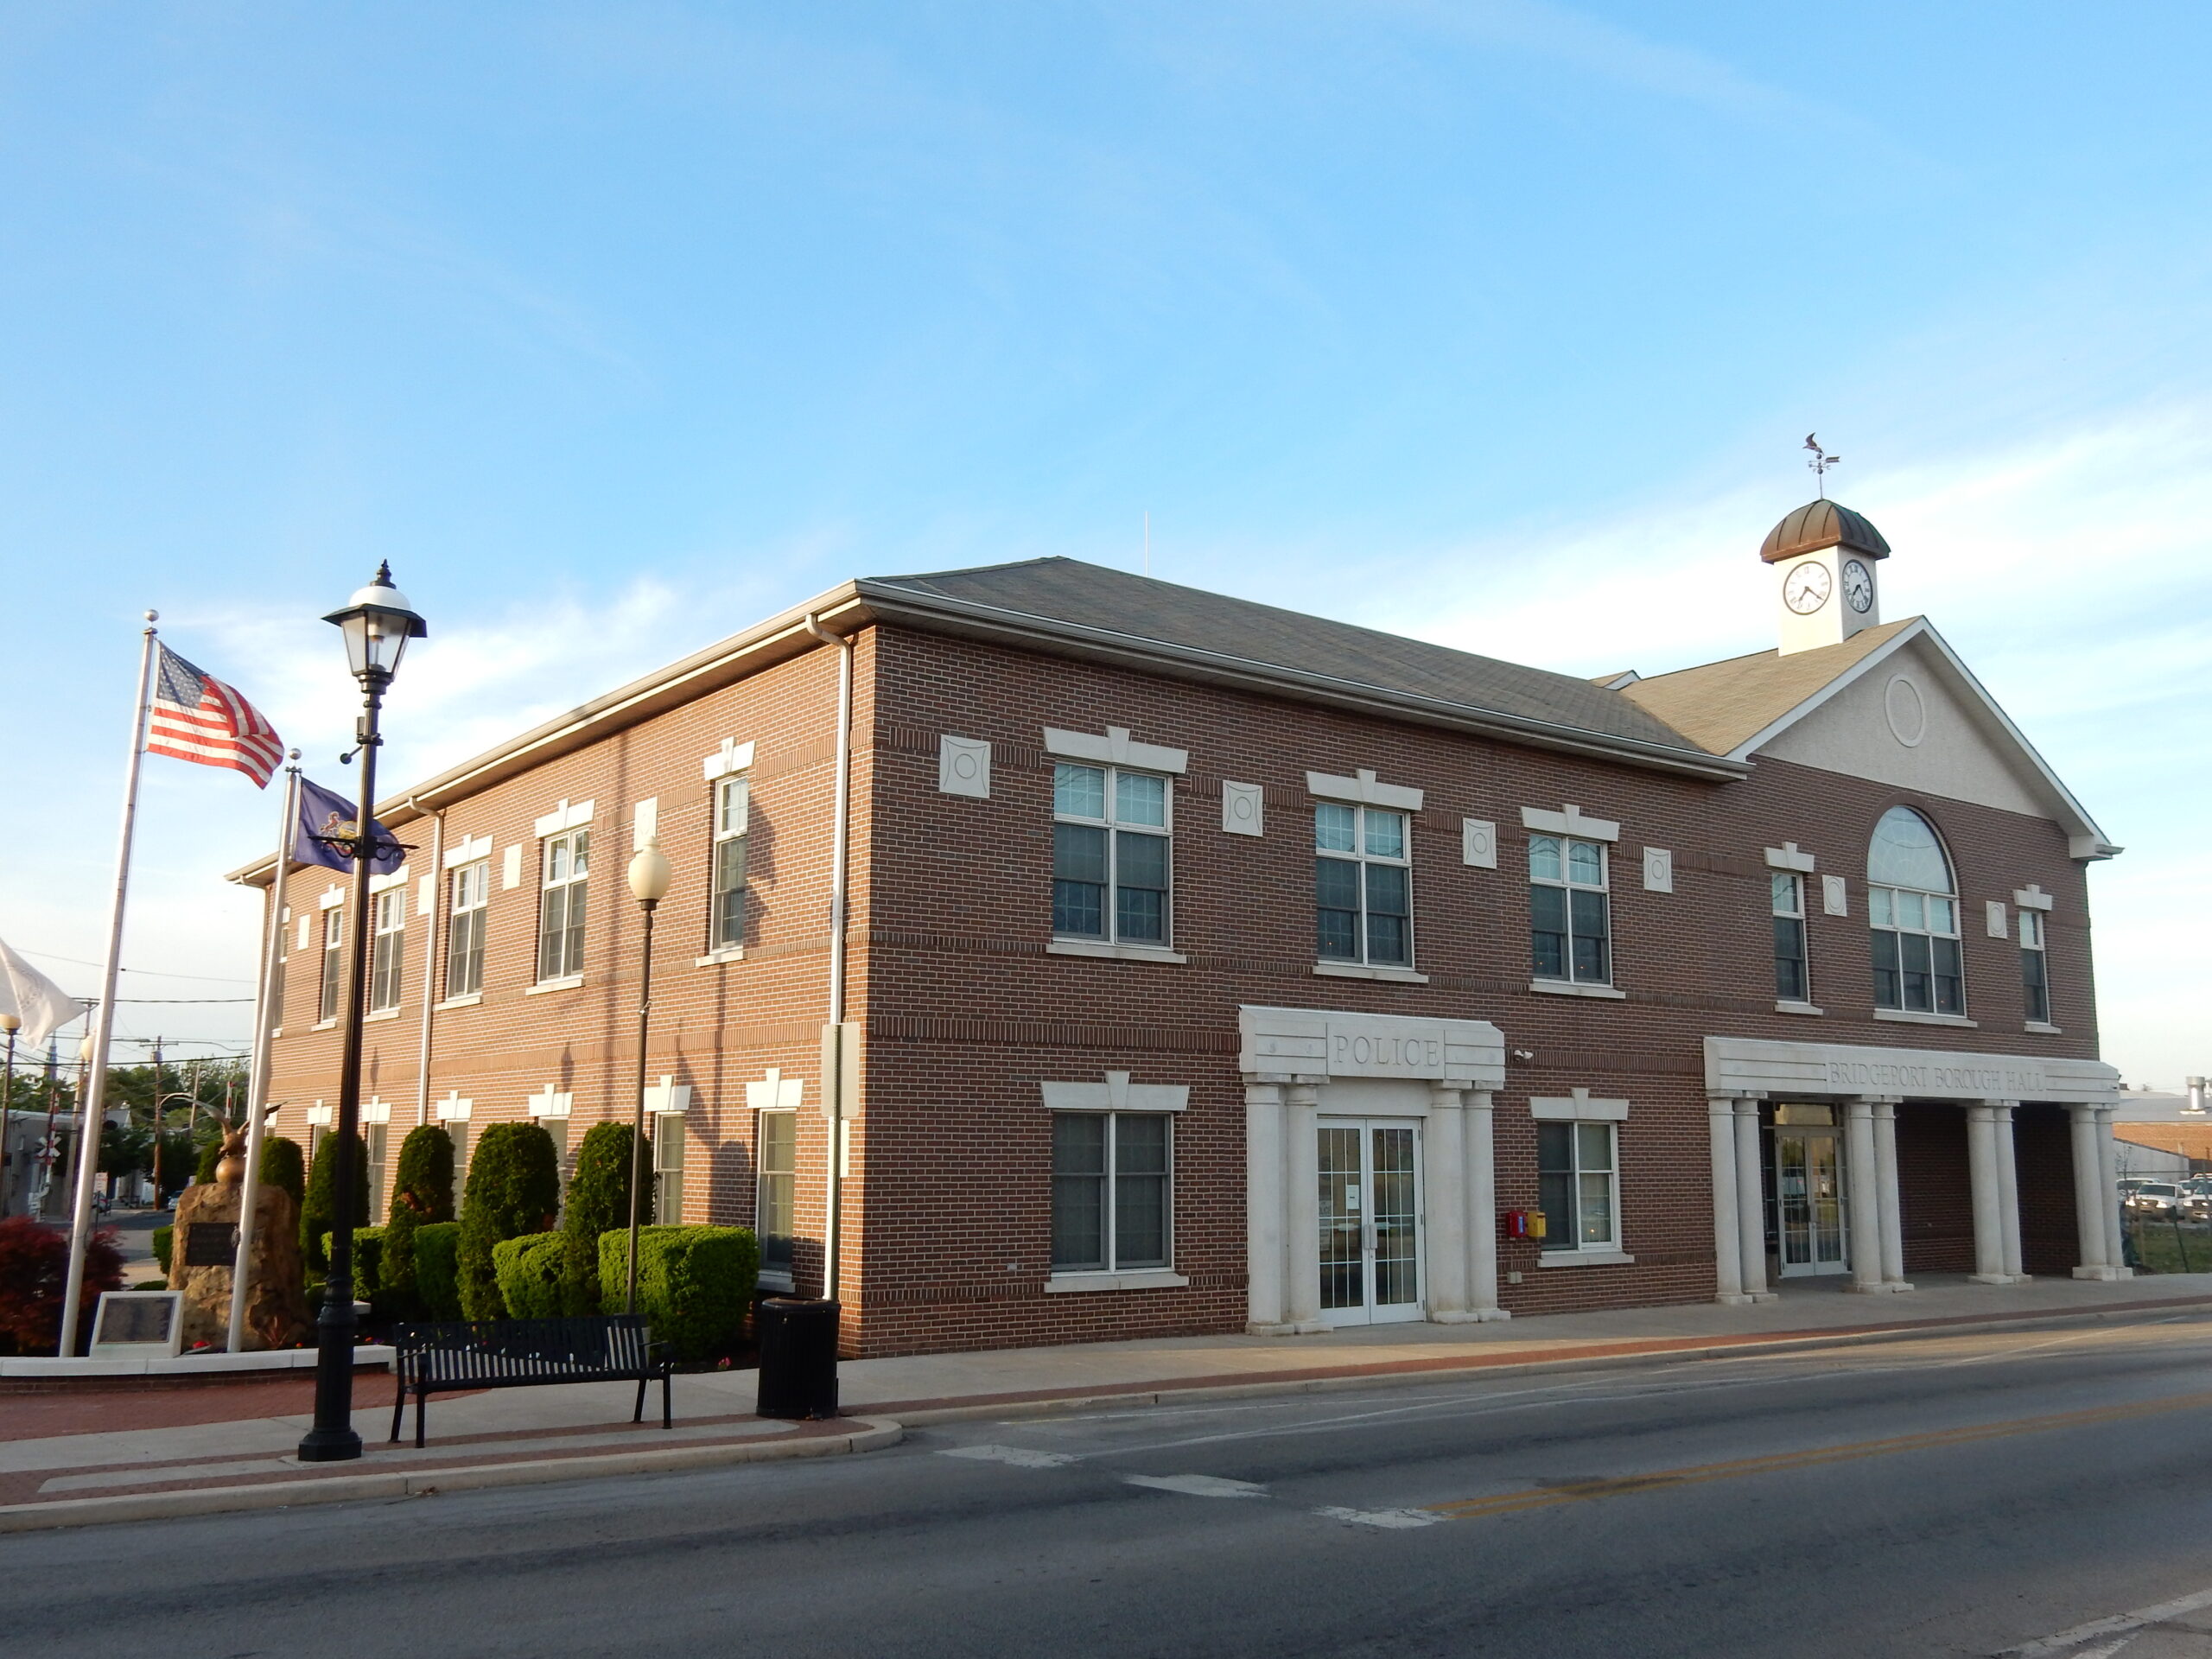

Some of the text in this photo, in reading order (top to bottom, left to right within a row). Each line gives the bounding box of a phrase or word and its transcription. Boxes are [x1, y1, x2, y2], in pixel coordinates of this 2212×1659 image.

[1333, 1035, 1440, 1067] POLICE
[1828, 1062, 2044, 1091] BRIDGEPORT BOROUGH HALL
